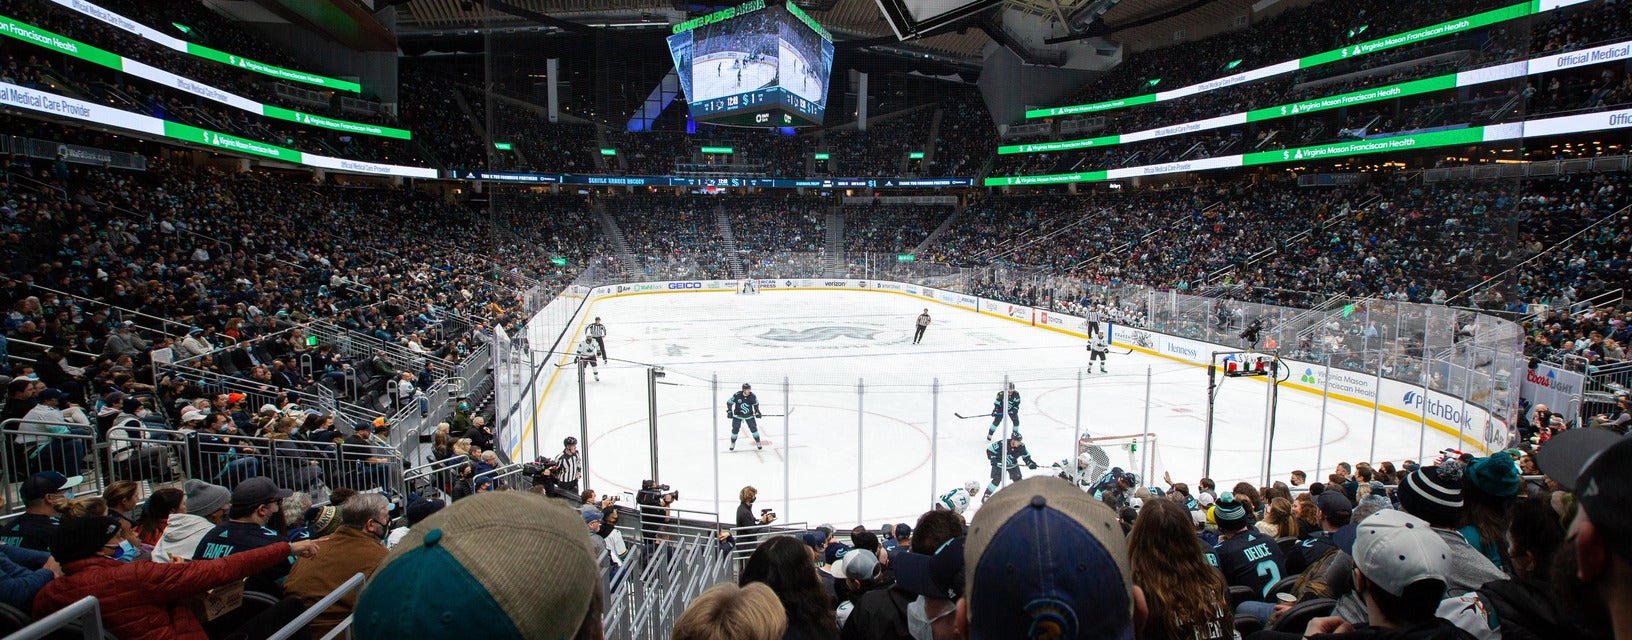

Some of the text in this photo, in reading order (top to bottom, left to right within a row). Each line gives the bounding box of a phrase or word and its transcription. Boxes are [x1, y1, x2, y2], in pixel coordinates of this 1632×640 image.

[672, 0, 766, 34] CLIMATE PLEDGE ARENA
[10, 23, 53, 45] Franciscan
[53, 38, 78, 53] Health
[1360, 20, 1469, 52] Virginia Mason Franciscan Health
[1557, 45, 1630, 67] Official Medical
[10, 88, 41, 105] Medical
[42, 96, 62, 111] Care
[62, 100, 91, 117] Provider
[1299, 86, 1401, 112] Virginia Mason Franciscan Health
[1303, 138, 1415, 159] Virginia Mason Franciscan Health
[668, 282, 701, 290] GEICO
[1168, 342, 1197, 359] Hennessy
[1344, 374, 1368, 387] Mason
[1527, 369, 1573, 394] Coors LIGHT
[1243, 542, 1272, 562] DEUCE
[1256, 560, 1281, 599] 2
